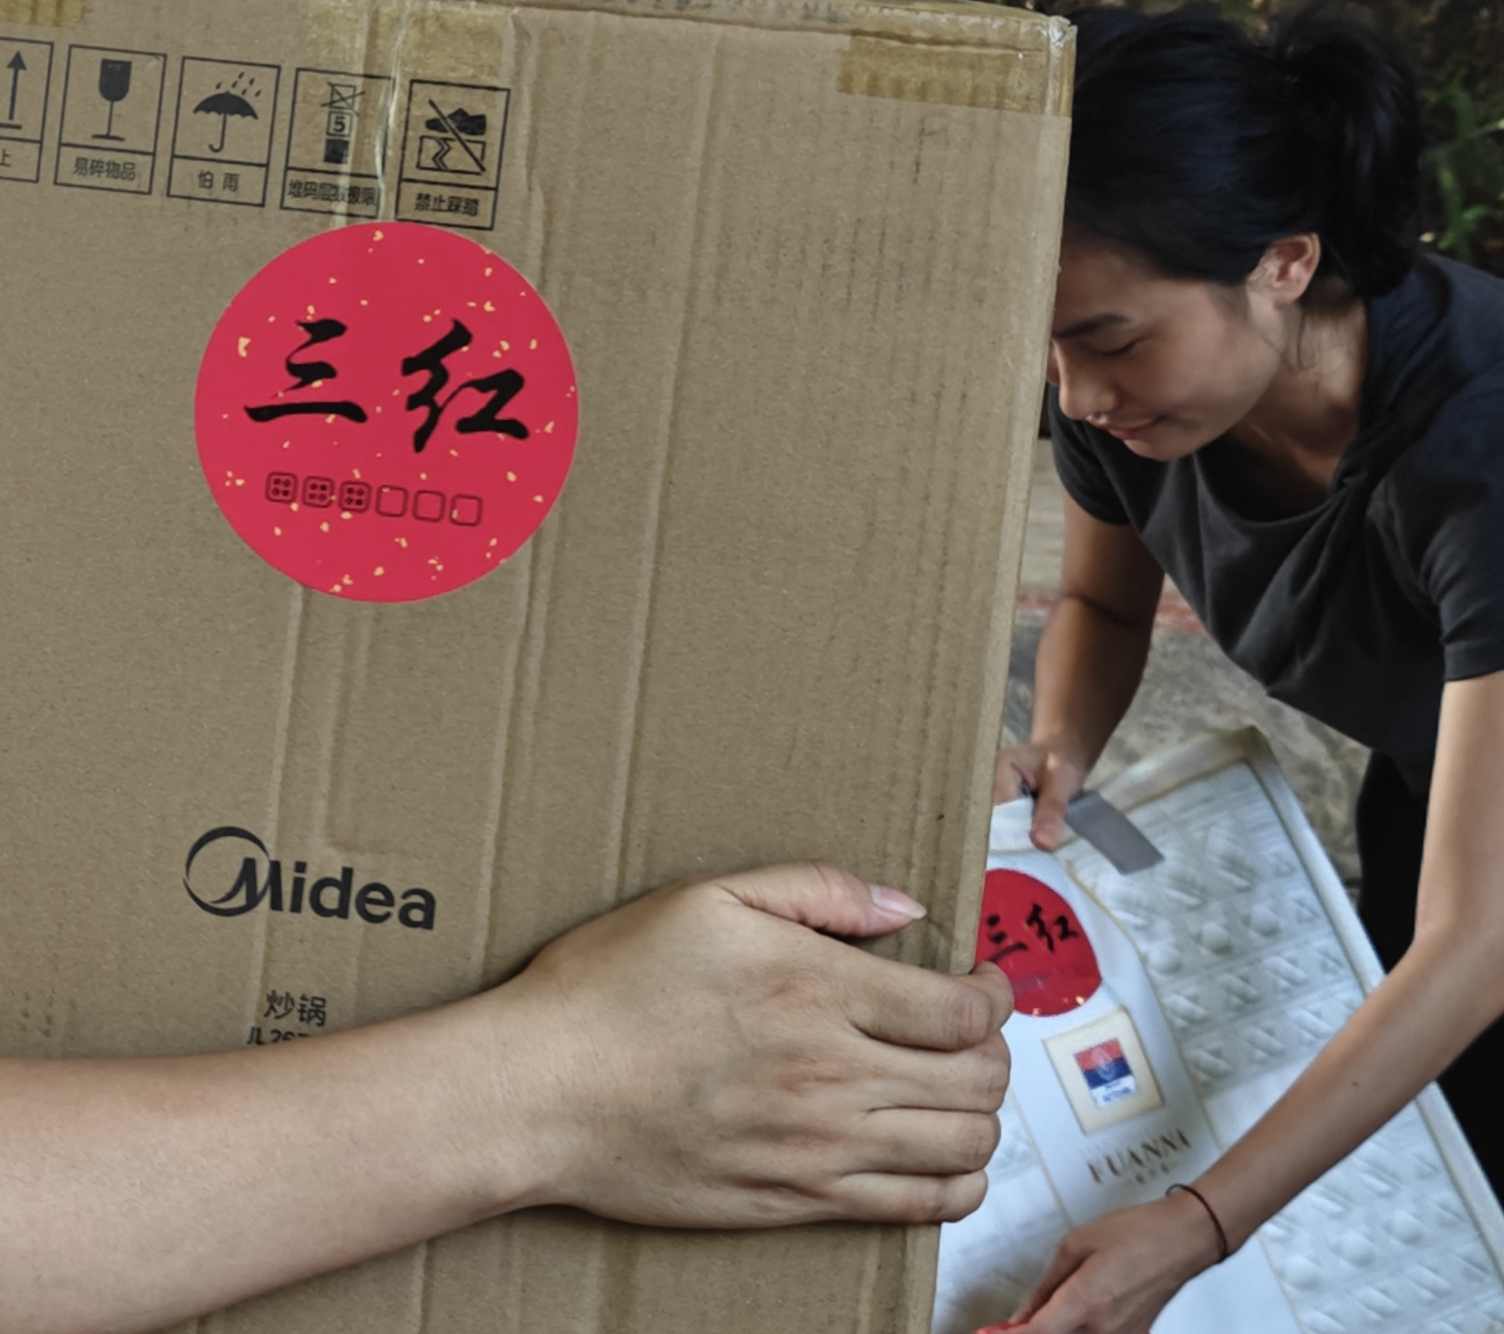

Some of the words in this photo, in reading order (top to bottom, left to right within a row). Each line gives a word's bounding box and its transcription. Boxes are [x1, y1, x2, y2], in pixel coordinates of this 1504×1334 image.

[332, 115, 346, 134] 5
[72, 156, 136, 182] 易碎物品
[197, 169, 240, 192] 怕雨
[244, 318, 530, 454] 三红
[183, 826, 436, 931] Midea
[984, 901, 1080, 964] 三红
[263, 989, 328, 1028] 炒锅
